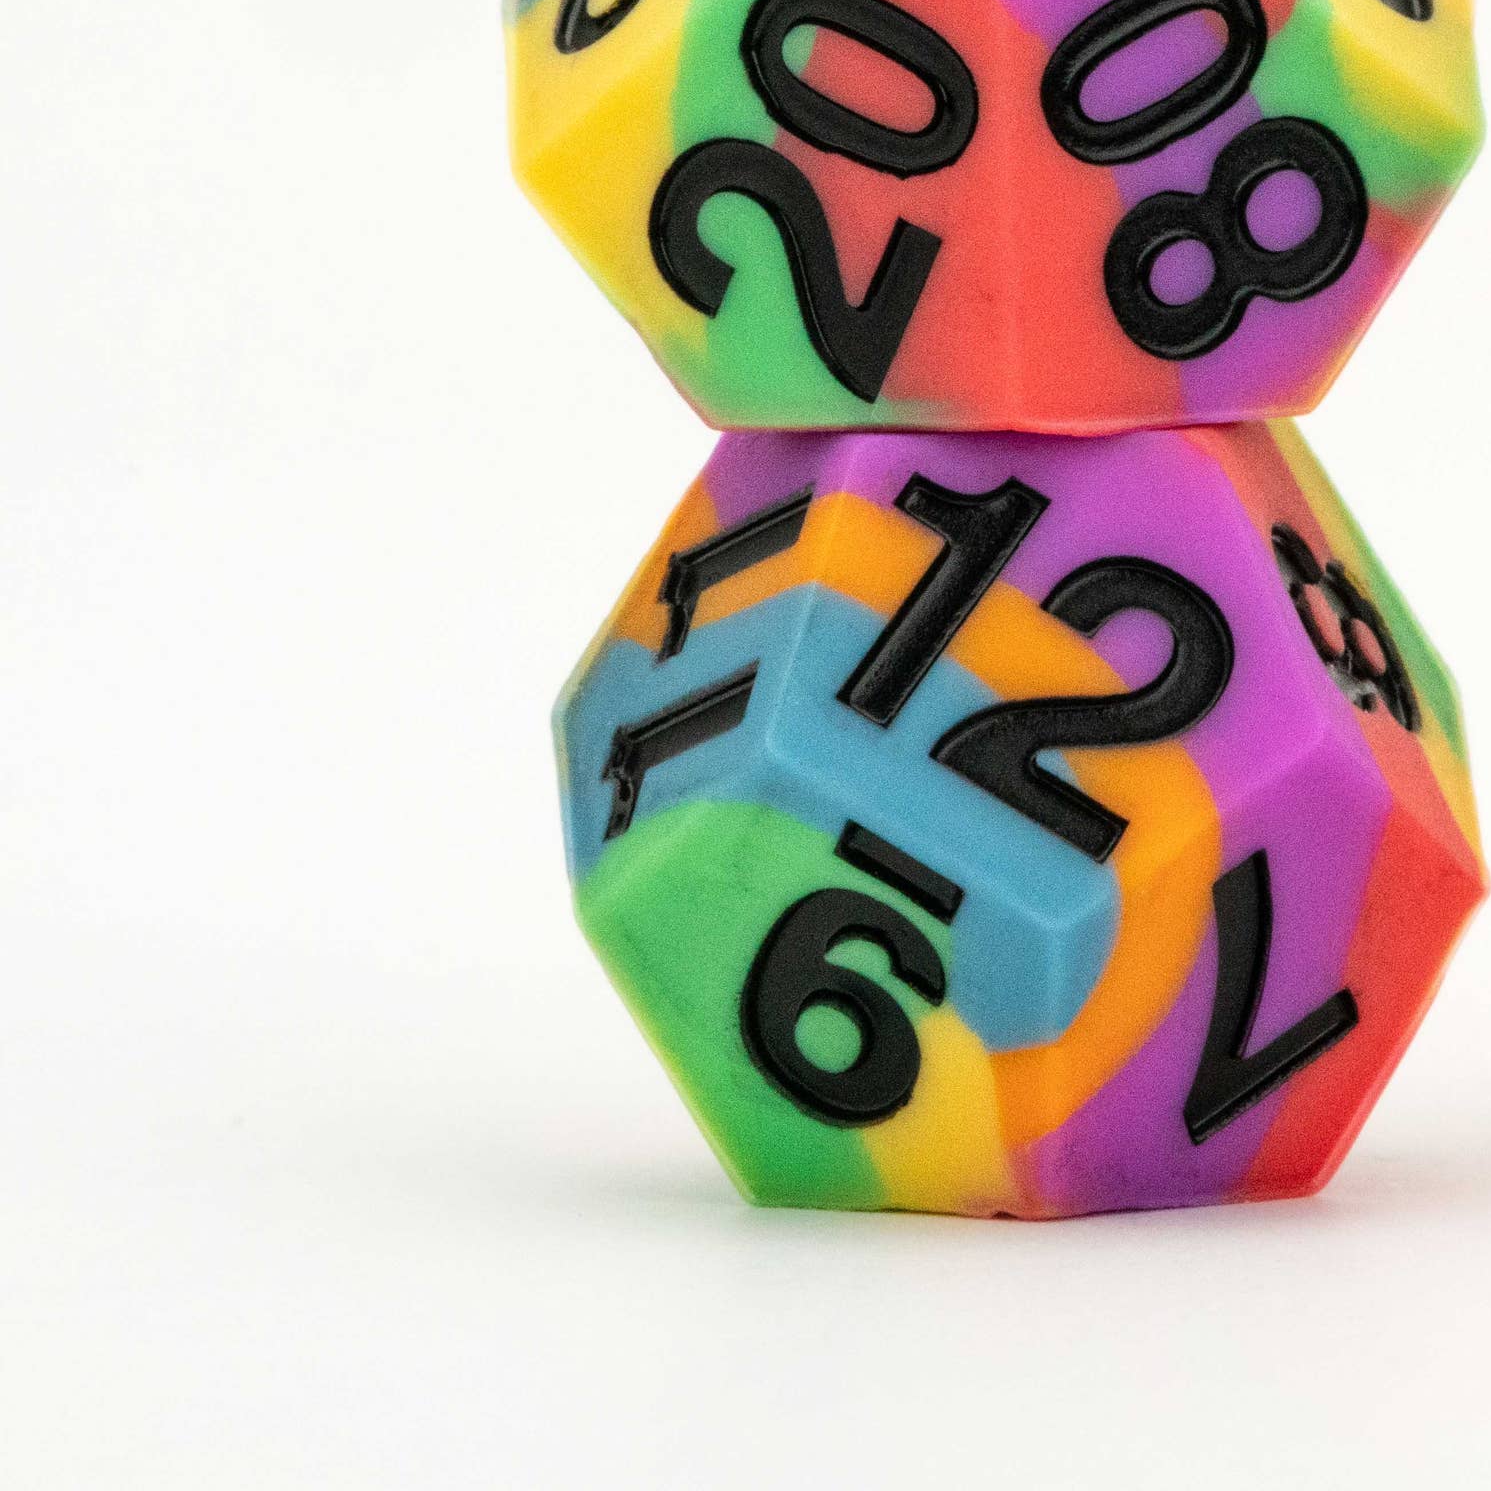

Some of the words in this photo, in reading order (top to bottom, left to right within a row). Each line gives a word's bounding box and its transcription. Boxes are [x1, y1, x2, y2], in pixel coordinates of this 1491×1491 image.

[600, 482, 816, 844] 11
[835, 470, 1237, 866] 12
[1182, 848, 1360, 1148] 7
